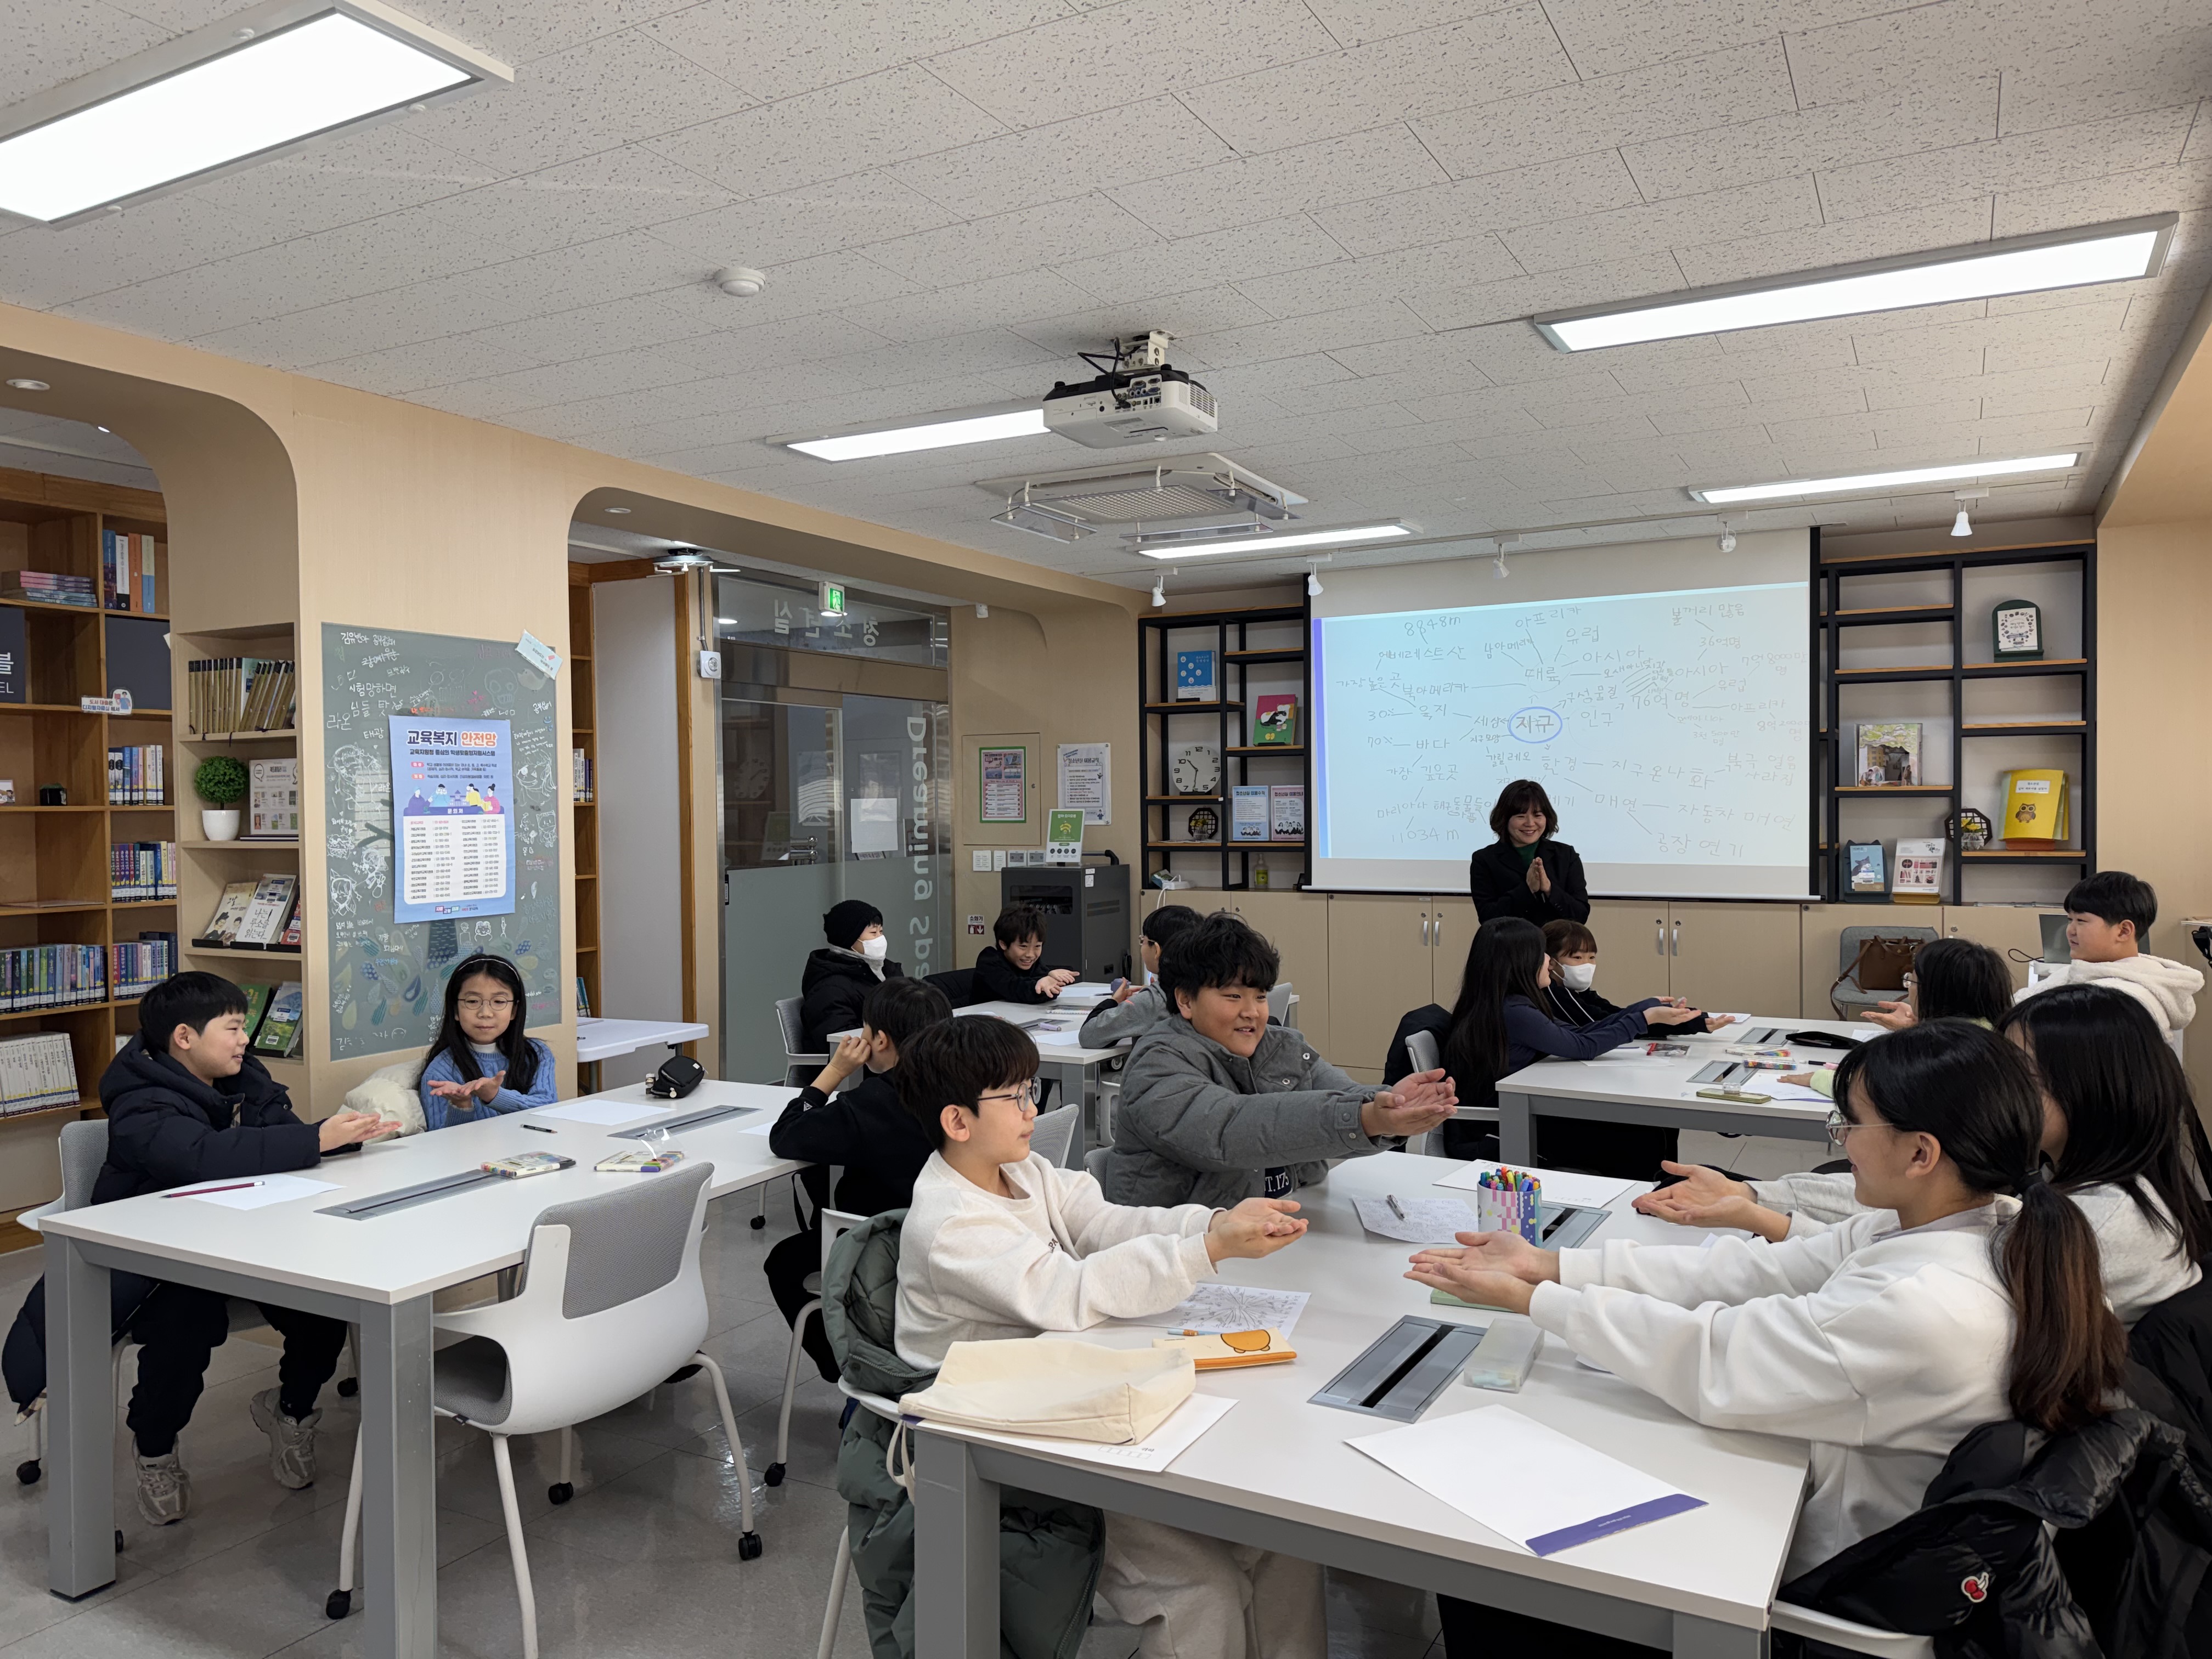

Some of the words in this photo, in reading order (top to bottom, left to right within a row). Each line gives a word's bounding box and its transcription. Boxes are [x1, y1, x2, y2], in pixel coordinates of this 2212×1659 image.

[1515, 606, 1581, 628] 아프리카
[1404, 616, 1460, 636] 8848m
[1566, 625, 1600, 645] 유럽
[1699, 636, 1741, 649] 36억명
[1582, 645, 1644, 663] 아시아
[1525, 667, 1561, 685] 대륙
[1675, 662, 1729, 678] 아시아
[349, 682, 396, 698] 시험망하면
[1336, 677, 1365, 687] 가장
[1718, 678, 1747, 692] 유럽
[1403, 682, 1469, 701] 북아메리카
[1566, 685, 1618, 703] 구성물질
[1419, 704, 1446, 720] 육지
[1731, 699, 1787, 713] 아프리카
[1474, 715, 1501, 728] 세상
[1581, 709, 1613, 727] 인구
[407, 730, 458, 746] 교육복지
[461, 732, 496, 747] 안전망
[1417, 738, 1451, 749] 바다
[1486, 752, 1531, 767] 갈릴레오
[1542, 755, 1577, 776] 환경
[1386, 767, 1413, 781] 가장
[1378, 801, 1427, 817] 마리아나
[1595, 793, 1637, 812] 매연
[1678, 804, 1735, 823] 자동차
[1657, 833, 1691, 855] 공장
[255, 908, 268, 918] 나는
